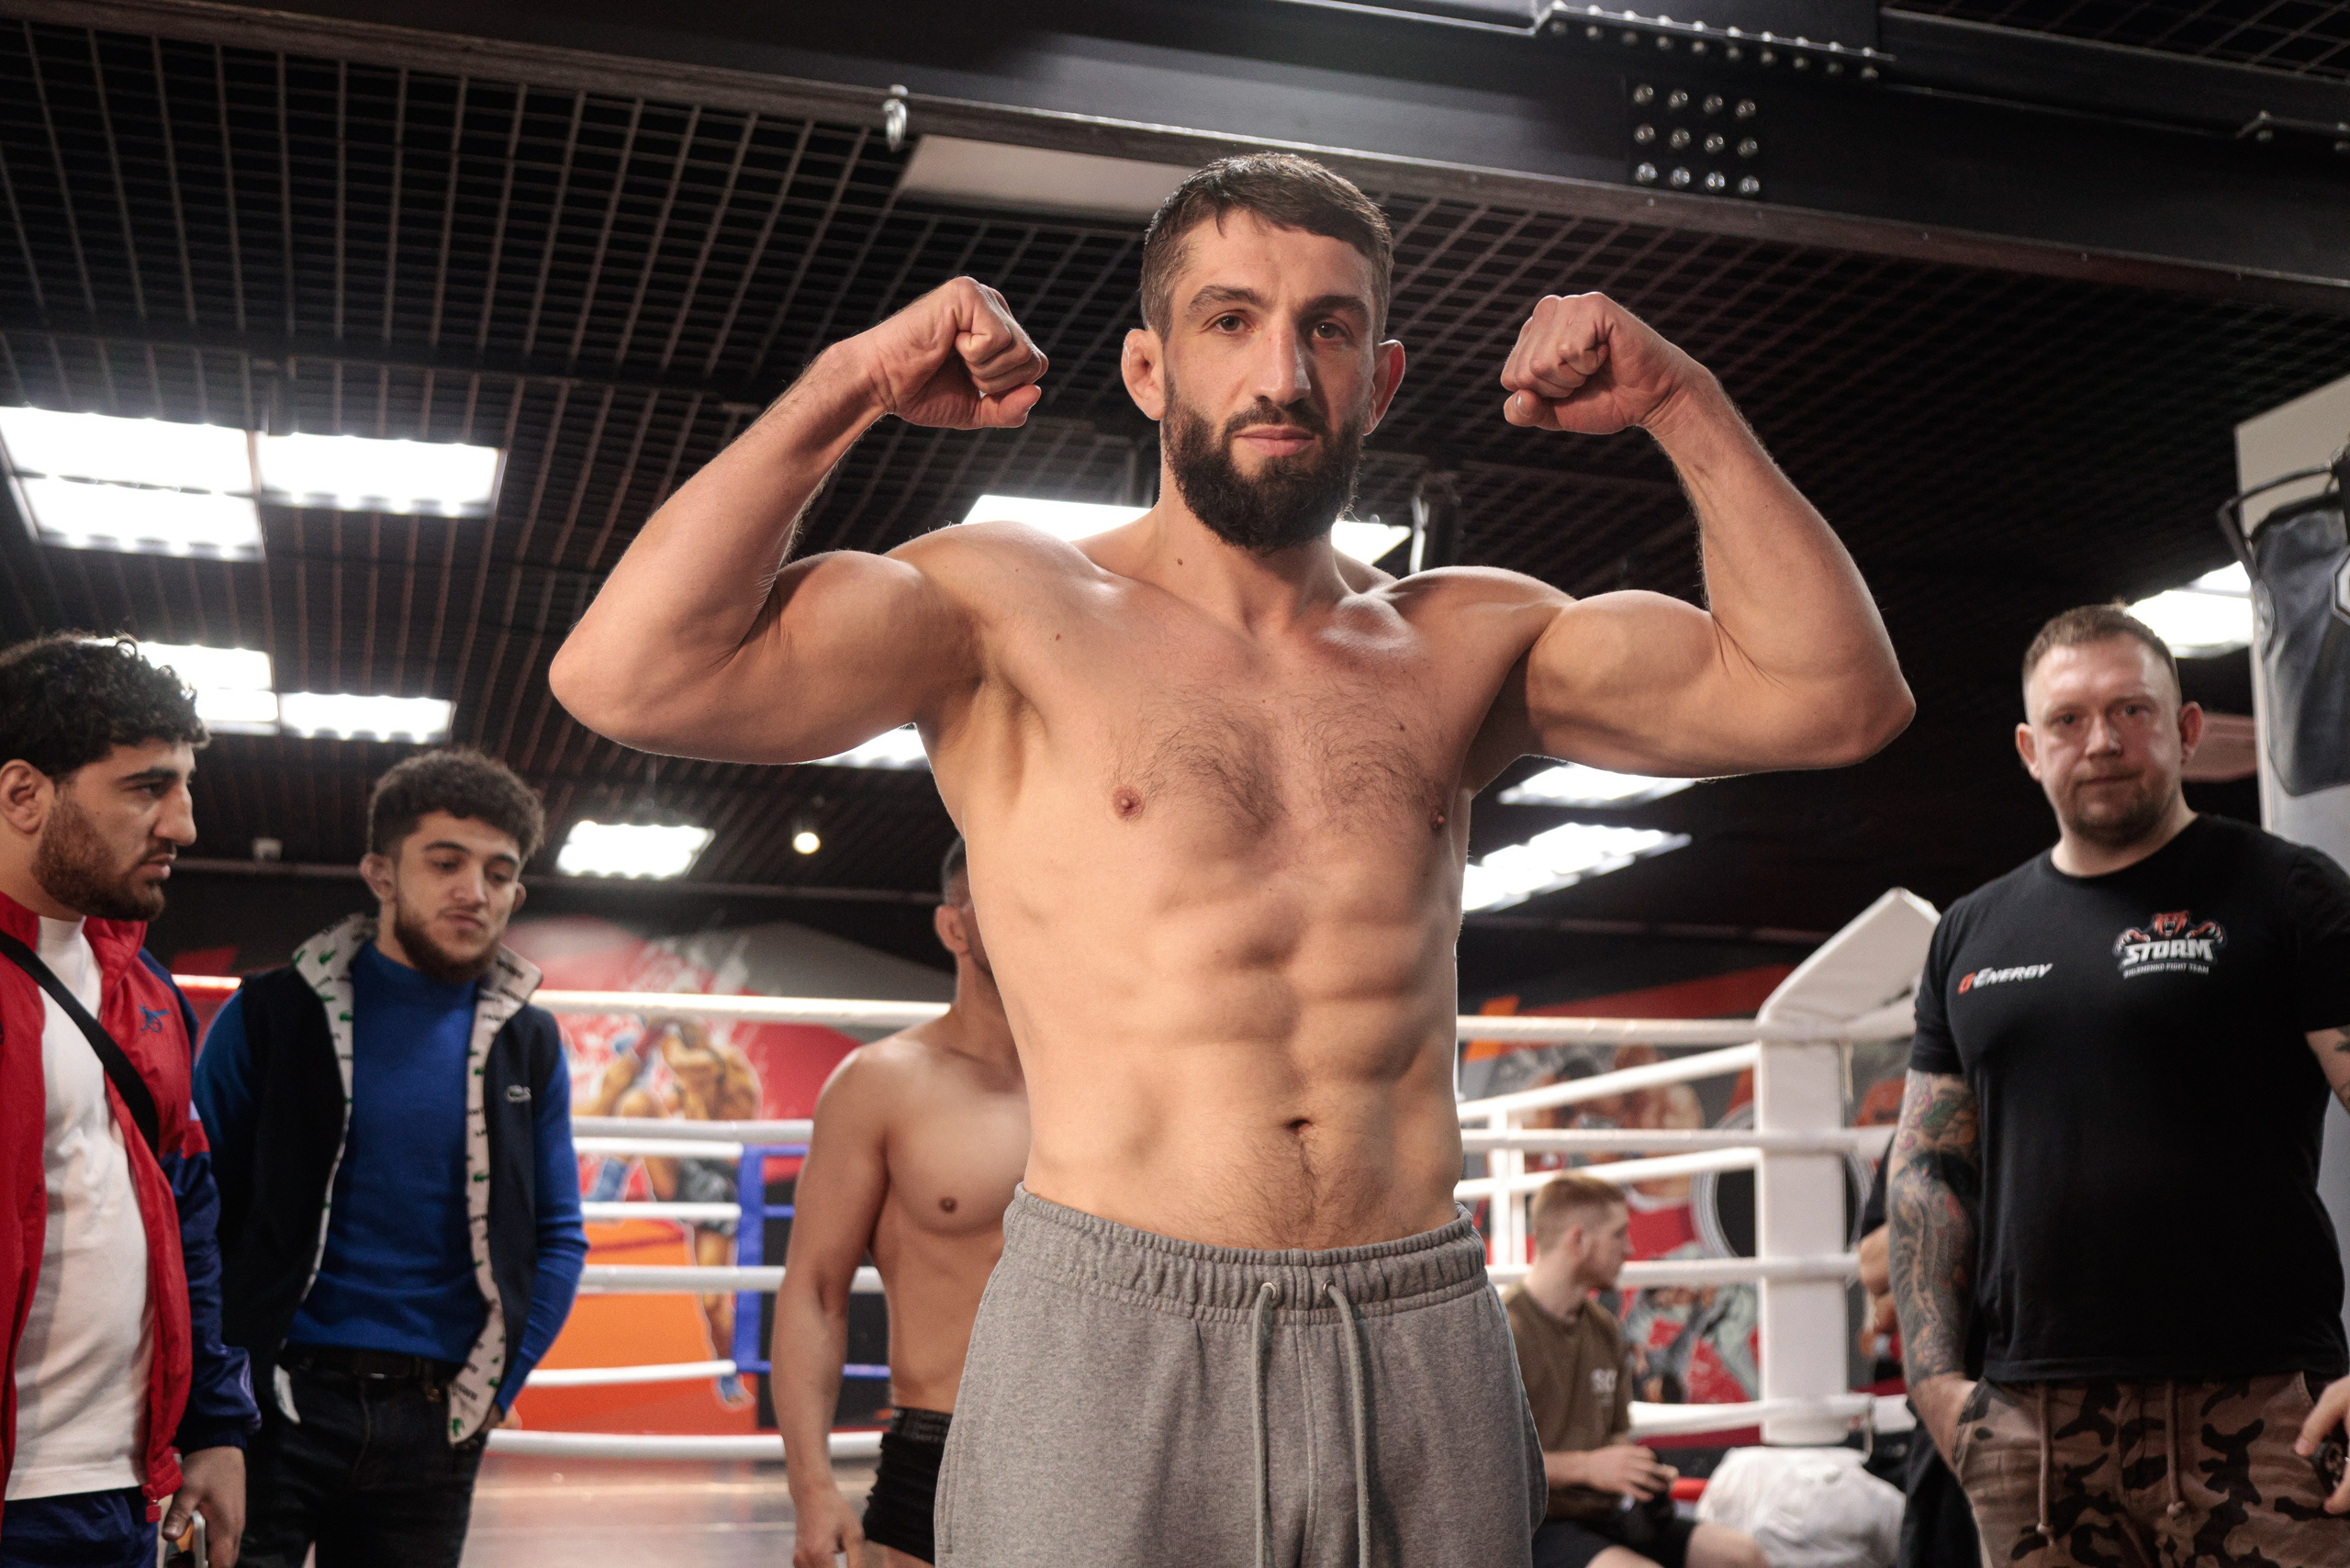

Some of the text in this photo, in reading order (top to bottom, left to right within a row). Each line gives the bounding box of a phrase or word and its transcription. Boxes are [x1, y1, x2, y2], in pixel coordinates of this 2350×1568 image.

[2121, 938, 2214, 968] STORM
[2166, 962, 2188, 972] FIGHT
[2188, 963, 2210, 975] TEAM
